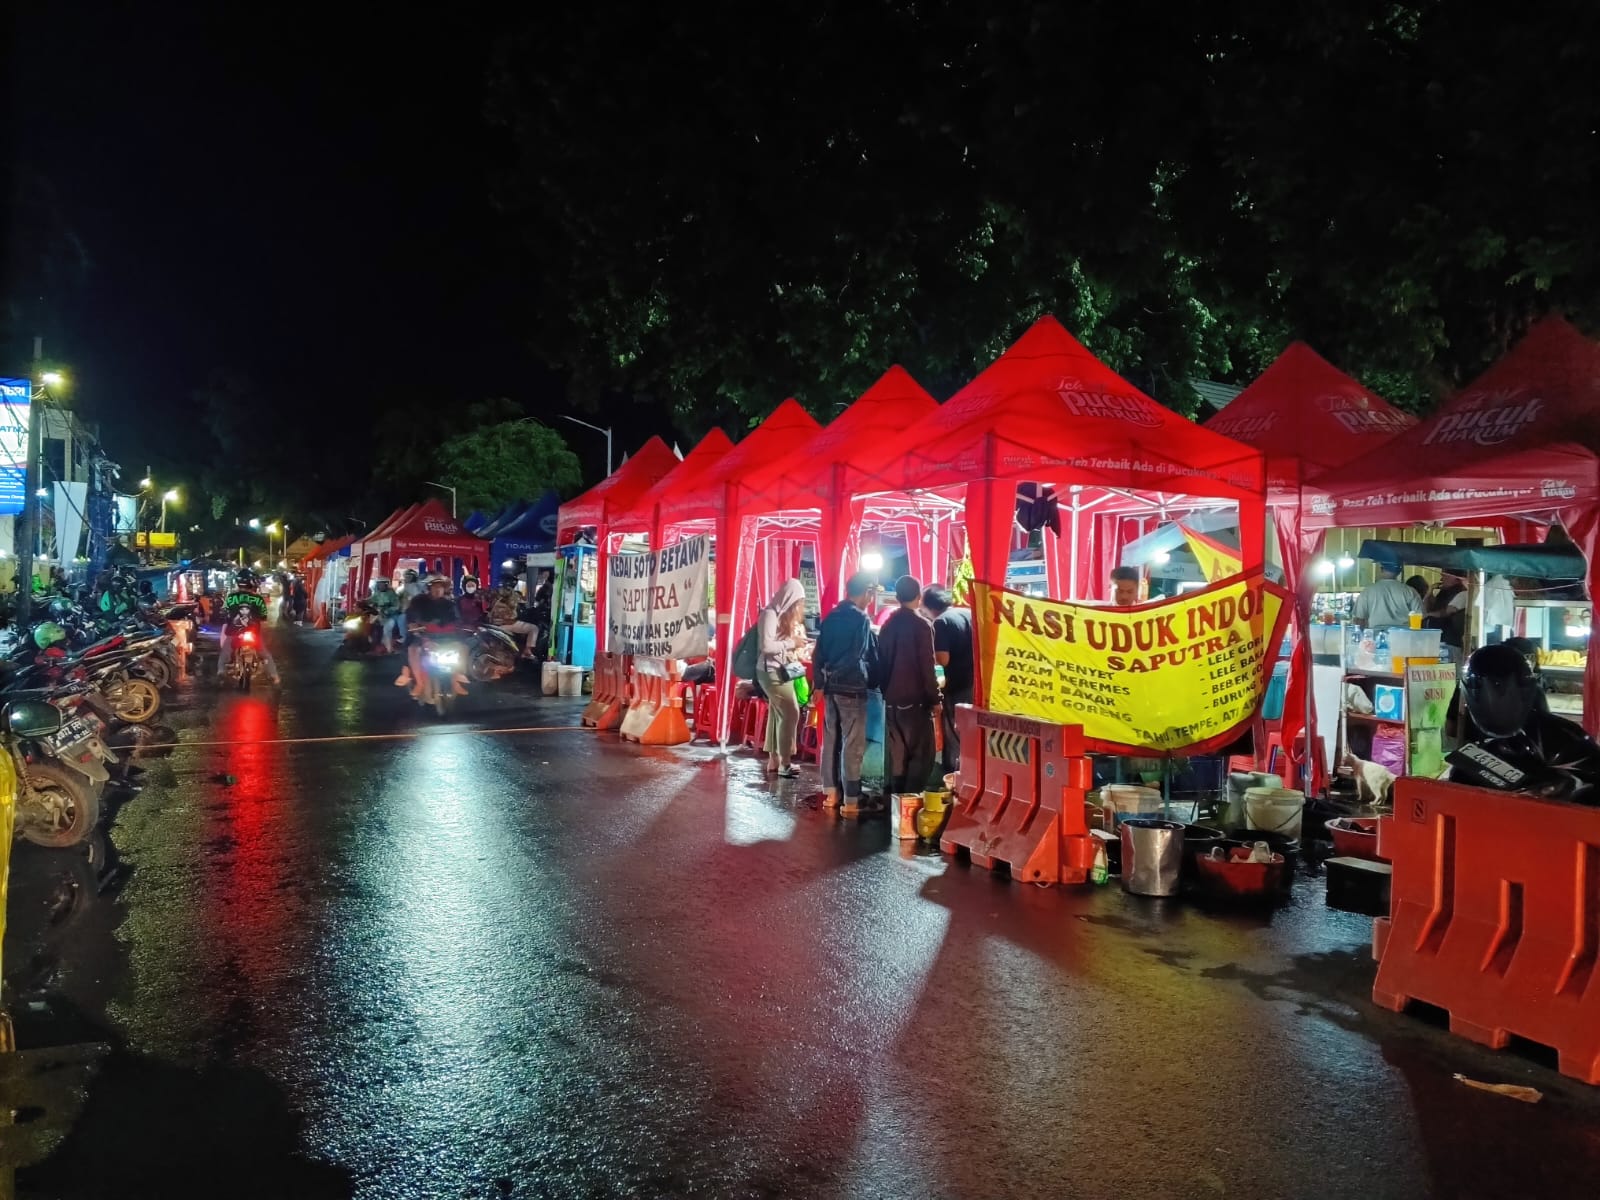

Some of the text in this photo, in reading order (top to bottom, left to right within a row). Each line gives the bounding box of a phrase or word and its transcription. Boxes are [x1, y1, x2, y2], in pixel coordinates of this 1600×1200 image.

[1091, 457, 1130, 470] Terbaik
[1132, 460, 1154, 473] Ada
[1156, 463, 1166, 473] di
[1428, 485, 1452, 501] Ada
[634, 551, 657, 579] SOTO
[989, 594, 1077, 643] NASI
[1084, 612, 1180, 653] UDUK
[1107, 629, 1243, 674] SAPUTRA
[1207, 649, 1235, 667] LELE
[1005, 646, 1115, 681] AYAM PENYET
[1209, 663, 1236, 681] LELE
[1006, 660, 1131, 696] AYAM KEREMES
[1008, 674, 1054, 691] AYAM
[1211, 671, 1249, 694] BEBEK
[1009, 687, 1133, 722] AYAM GORENG
[1424, 687, 1446, 701] SUSU
